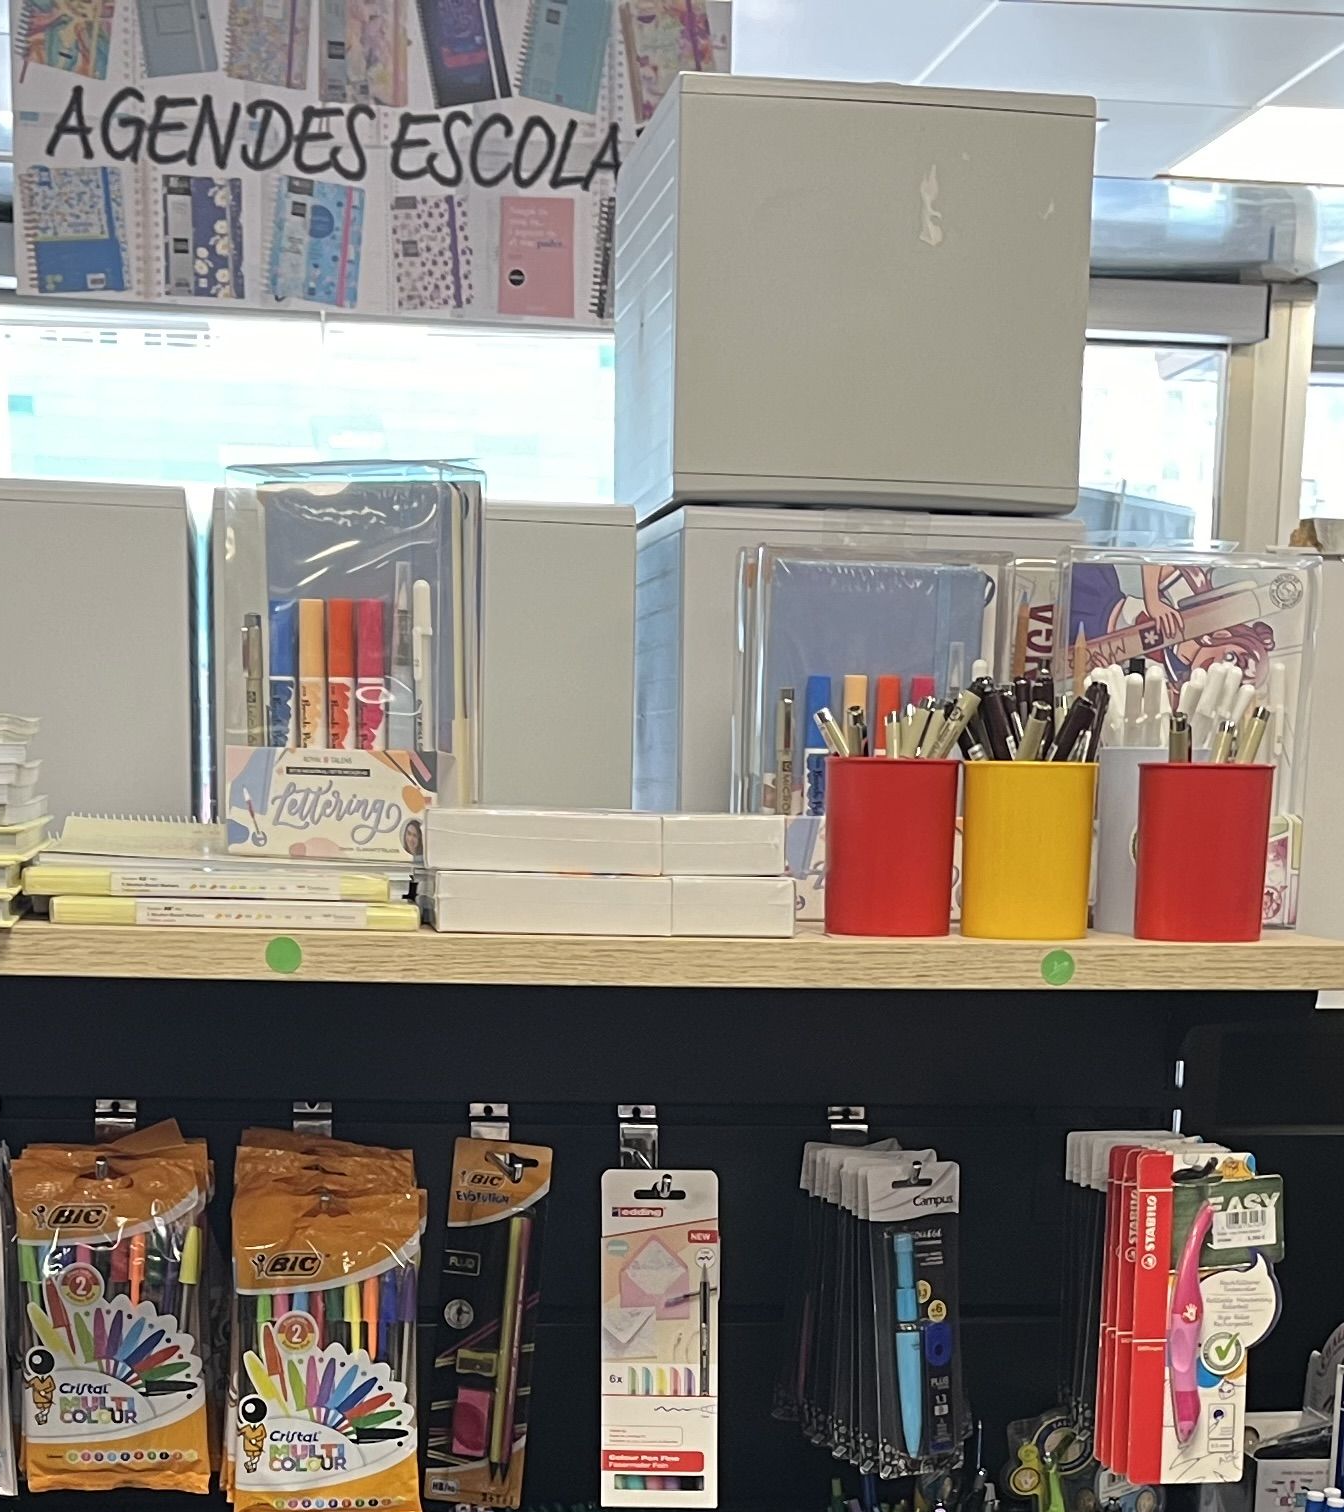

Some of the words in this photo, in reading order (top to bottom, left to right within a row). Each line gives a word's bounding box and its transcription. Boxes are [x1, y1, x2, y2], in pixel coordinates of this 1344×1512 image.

[45, 84, 377, 182] AGENDES
[391, 109, 650, 191] ESCOLA
[270, 779, 402, 846] Lettering
[470, 1173, 503, 1187] BIC
[912, 1195, 954, 1207] Campus
[56, 1209, 103, 1225] BIC
[620, 1207, 662, 1217] edding
[1144, 1194, 1158, 1252] STABILO
[690, 1232, 711, 1241] NEW
[270, 1256, 318, 1272] BIC
[75, 1276, 88, 1296] 2
[291, 1325, 303, 1343] 2
[59, 1382, 109, 1395] Cristal
[59, 1396, 135, 1412] MULTI
[59, 1409, 139, 1425] COLOUR
[269, 1430, 320, 1443] Cristal
[269, 1443, 345, 1460] MULTI
[269, 1457, 348, 1472] COLOUR
